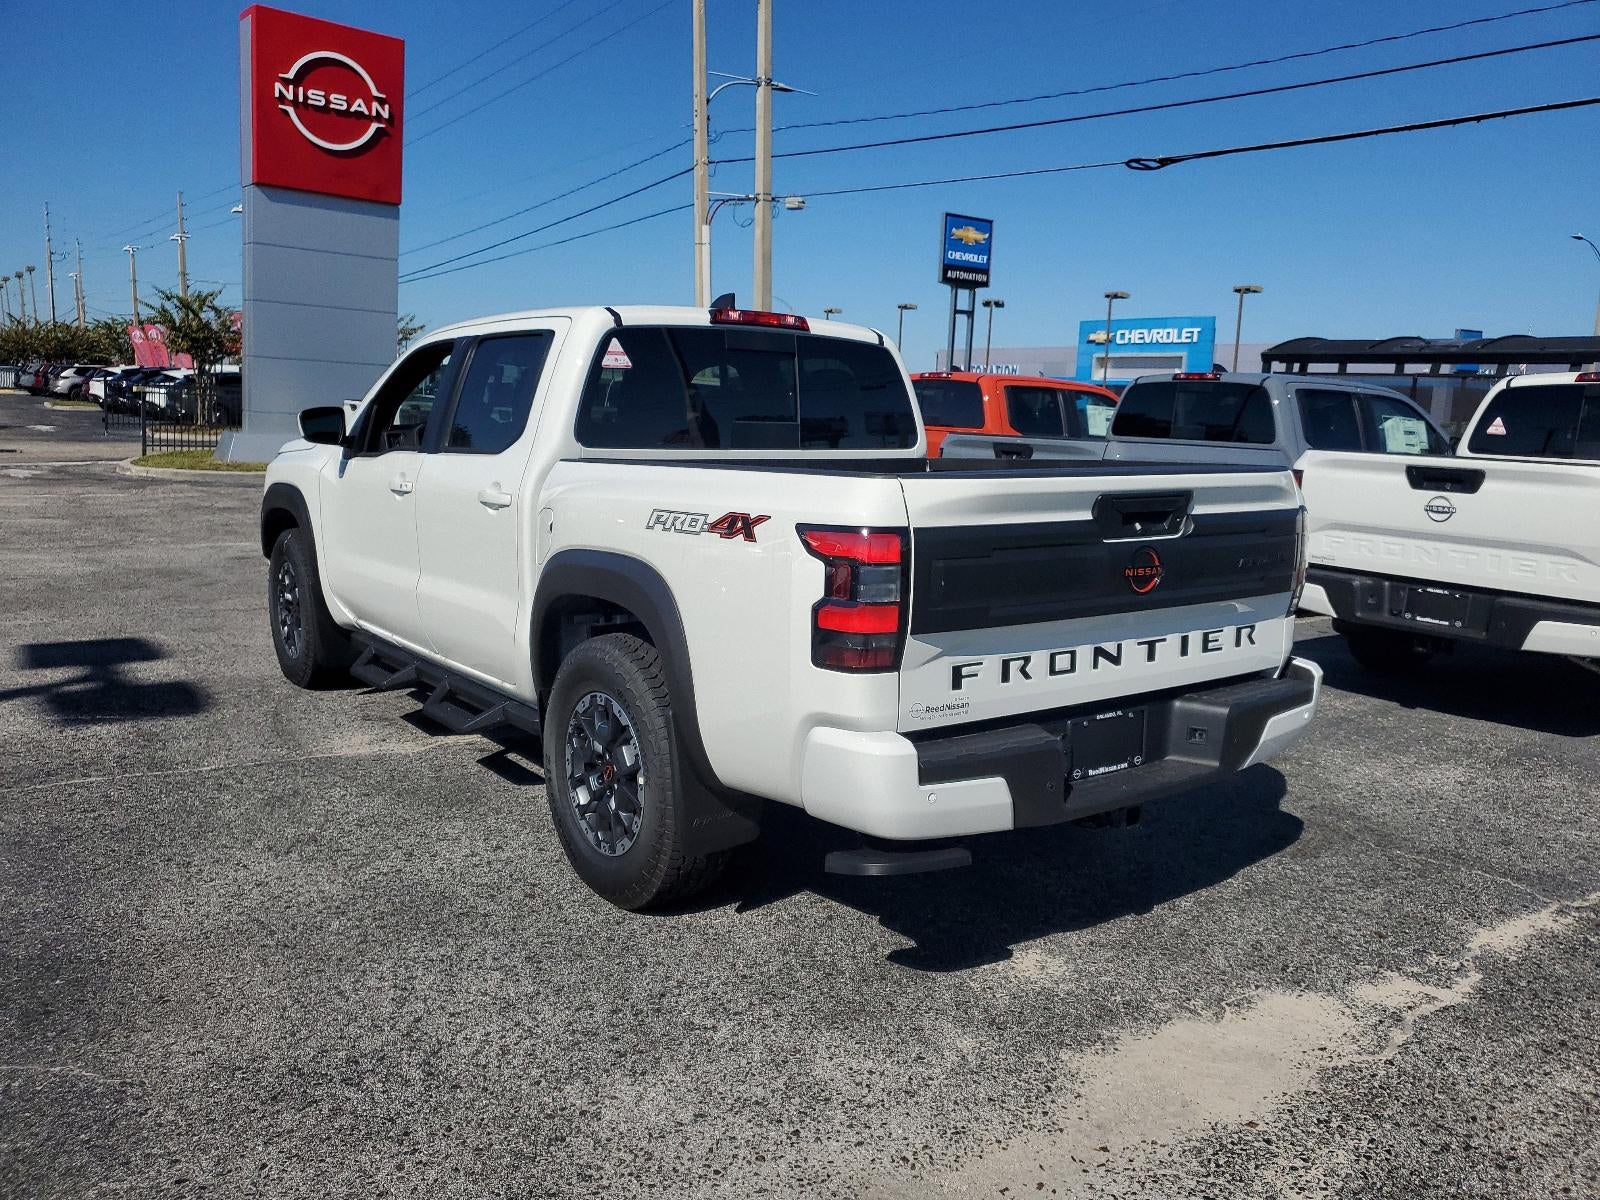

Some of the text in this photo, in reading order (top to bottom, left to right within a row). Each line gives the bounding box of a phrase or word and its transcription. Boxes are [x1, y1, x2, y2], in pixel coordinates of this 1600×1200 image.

[274, 82, 389, 119] NISSAN
[948, 250, 988, 264] CHEVROLET
[947, 270, 988, 282] AUTONATION
[1115, 327, 1201, 345] CHEVROLET
[1424, 505, 1456, 513] NISSAN
[646, 509, 771, 543] PRO-4X
[1323, 534, 1581, 583] FRONTIER
[1125, 566, 1163, 577] NISSAN
[951, 624, 1256, 691] FRONTIER
